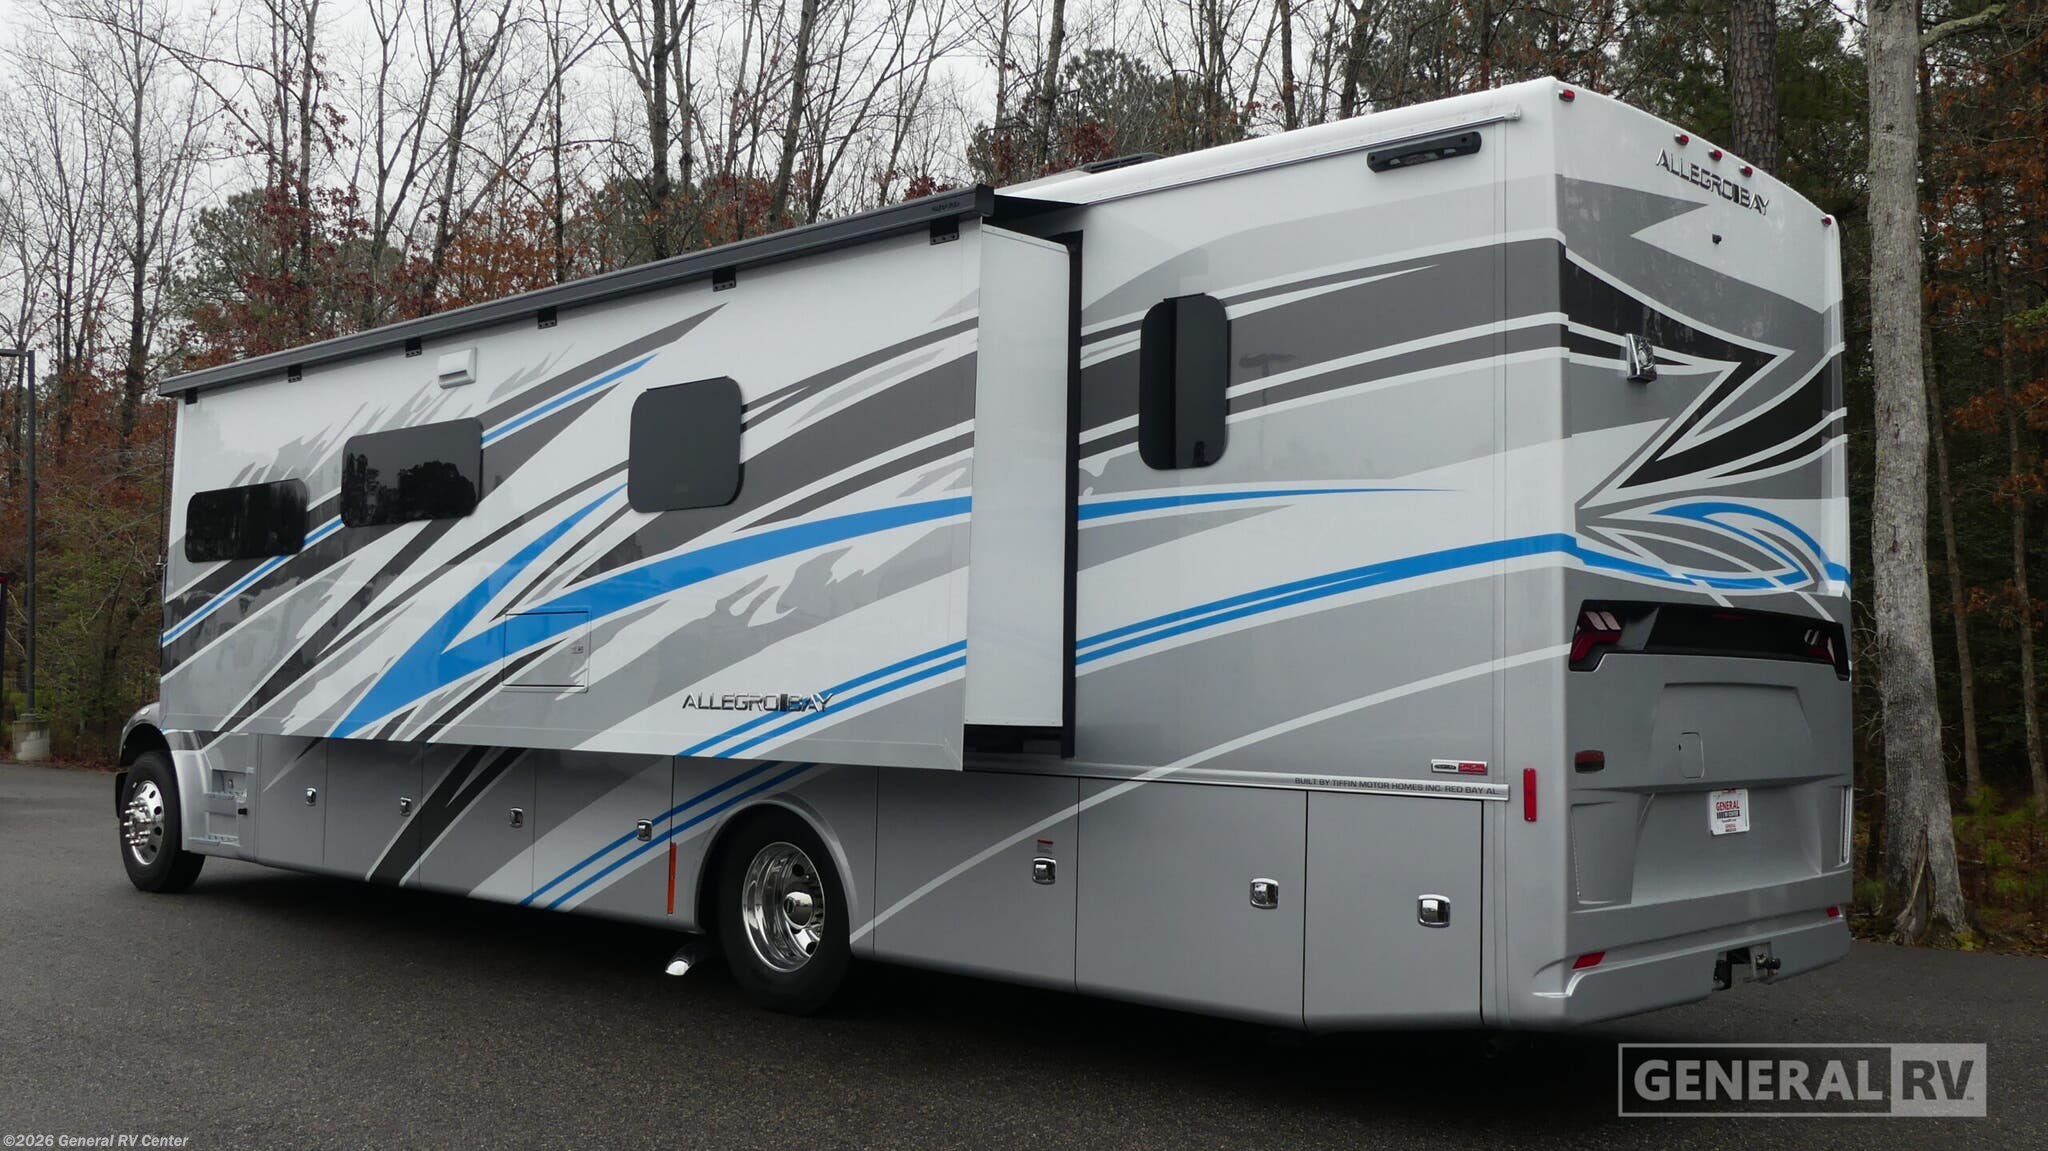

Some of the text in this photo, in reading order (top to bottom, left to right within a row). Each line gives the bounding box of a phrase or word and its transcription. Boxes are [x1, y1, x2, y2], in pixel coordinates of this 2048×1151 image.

[1656, 149, 1769, 216] ALLEGRO BAY
[682, 692, 833, 713] ALLEGRO BAY
[1295, 777, 1316, 785] BUILT
[1319, 778, 1329, 786] BY
[1332, 779, 1357, 788] TIFFIN
[1359, 781, 1390, 790] MOTOR
[1391, 782, 1424, 792] HOMES
[1444, 785, 1463, 793] RED
[1465, 786, 1484, 794] BAY
